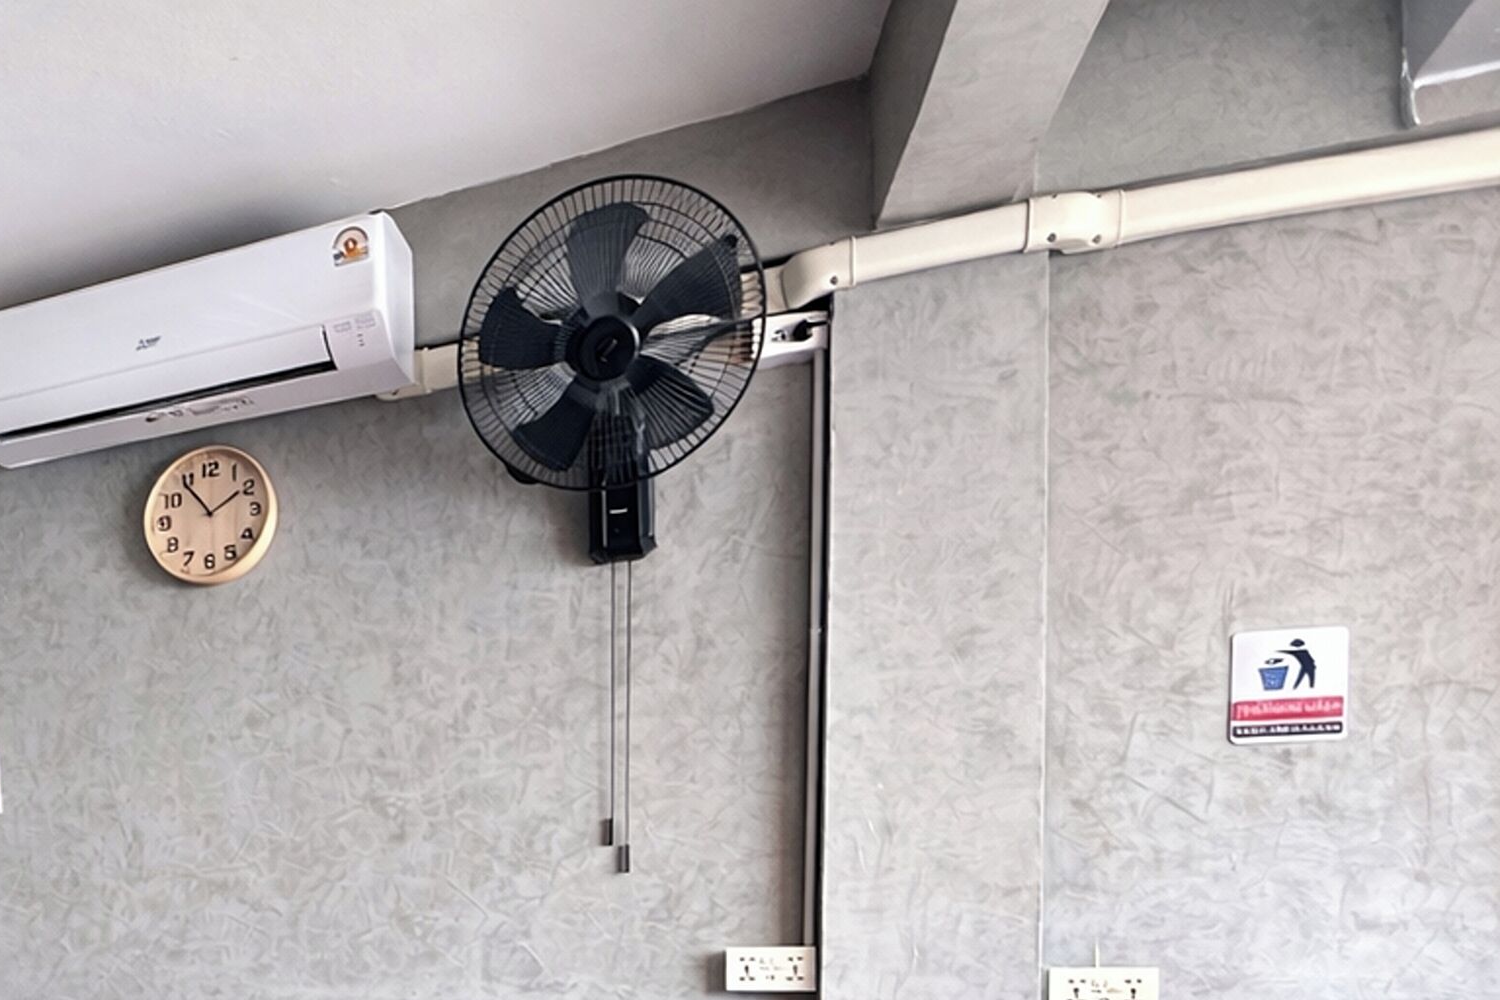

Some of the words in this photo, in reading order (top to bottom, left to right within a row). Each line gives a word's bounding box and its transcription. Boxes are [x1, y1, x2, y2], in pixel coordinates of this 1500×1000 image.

[202, 461, 220, 478] 12
[232, 463, 237, 481] 1
[242, 479, 255, 496] 2
[164, 493, 182, 509] 10
[250, 502, 261, 516] 3
[158, 516, 171, 531] 9
[241, 528, 254, 540] 4
[167, 537, 179, 553] 8
[224, 544, 237, 560] 5
[183, 551, 194, 567] 7
[204, 553, 216, 570] 6
